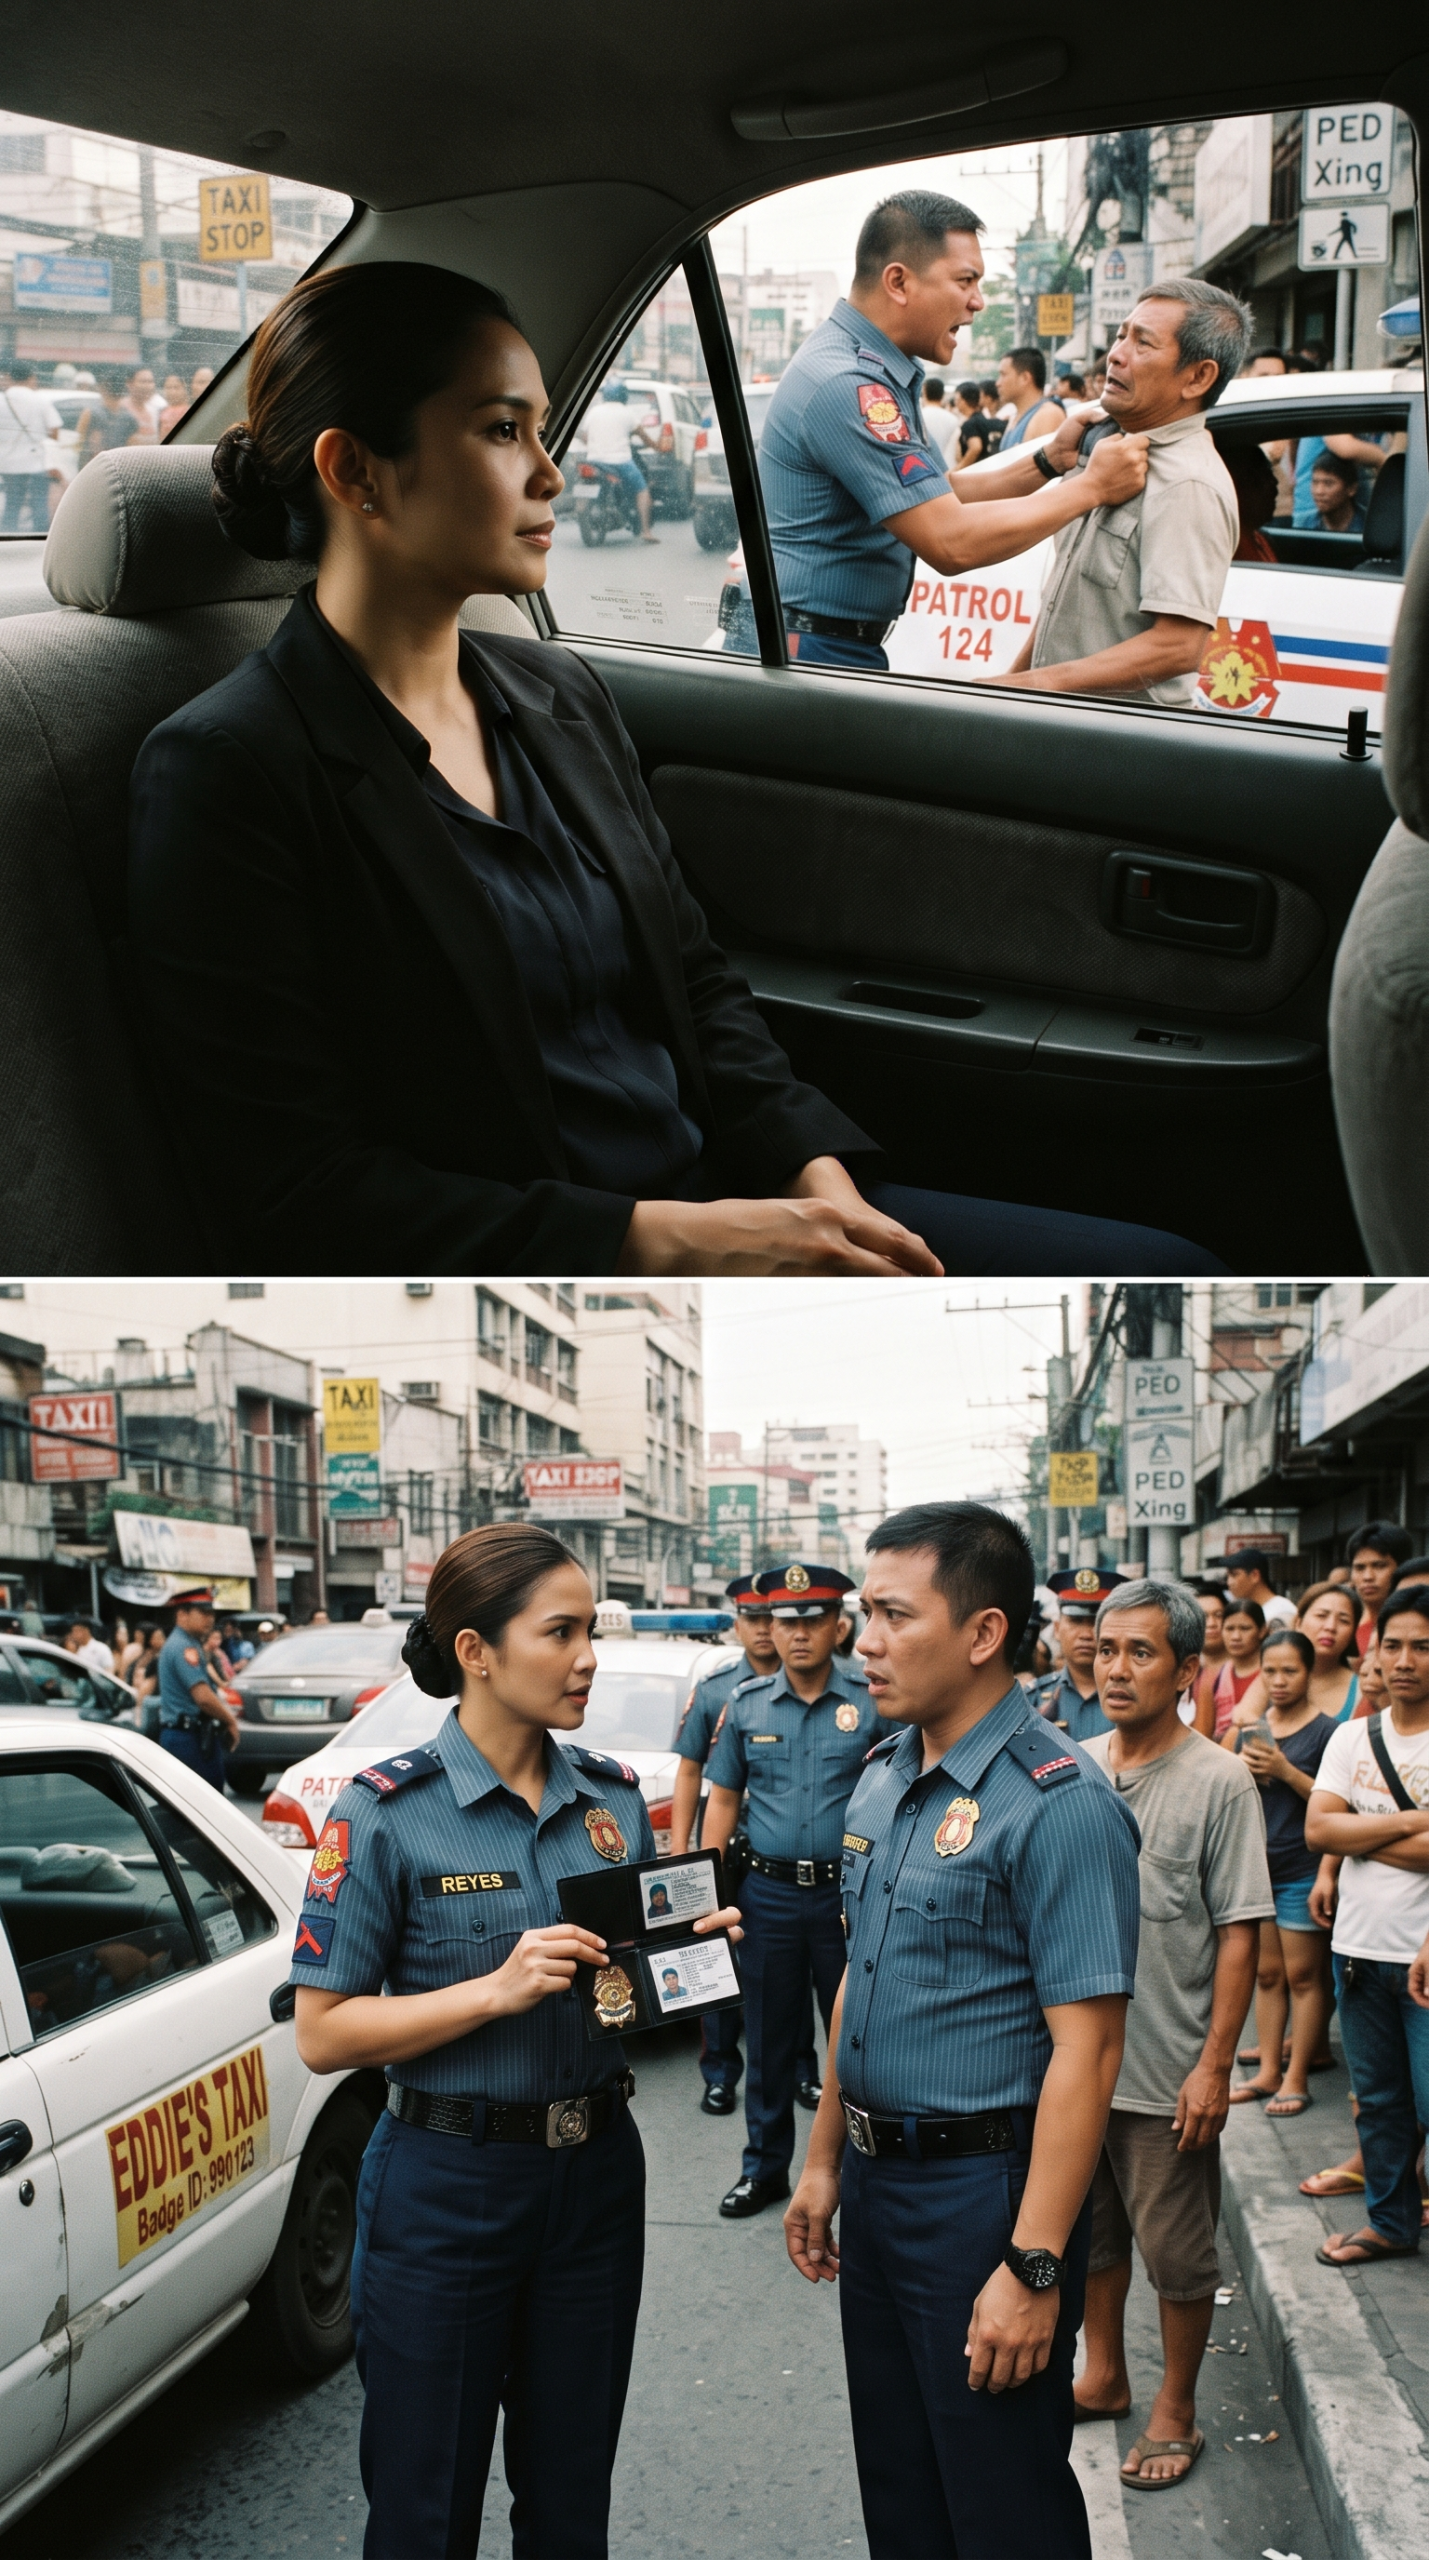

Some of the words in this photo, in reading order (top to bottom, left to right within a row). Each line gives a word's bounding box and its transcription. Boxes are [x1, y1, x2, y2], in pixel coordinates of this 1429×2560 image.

[1317, 112, 1382, 146] PED
[1314, 157, 1383, 192] Xing
[207, 184, 262, 215] TAXI
[206, 220, 264, 252] STOP
[910, 579, 1032, 625] PATROL
[938, 625, 993, 663] 124
[328, 1384, 375, 1413] TAXI
[1135, 1470, 1185, 1491] PED
[1134, 1499, 1187, 1521] Xing
[441, 1873, 504, 1894] REYES
[107, 2080, 213, 2213] EDDIE'S
[211, 2047, 269, 2143] TAXI
[137, 2191, 185, 2247] Badge
